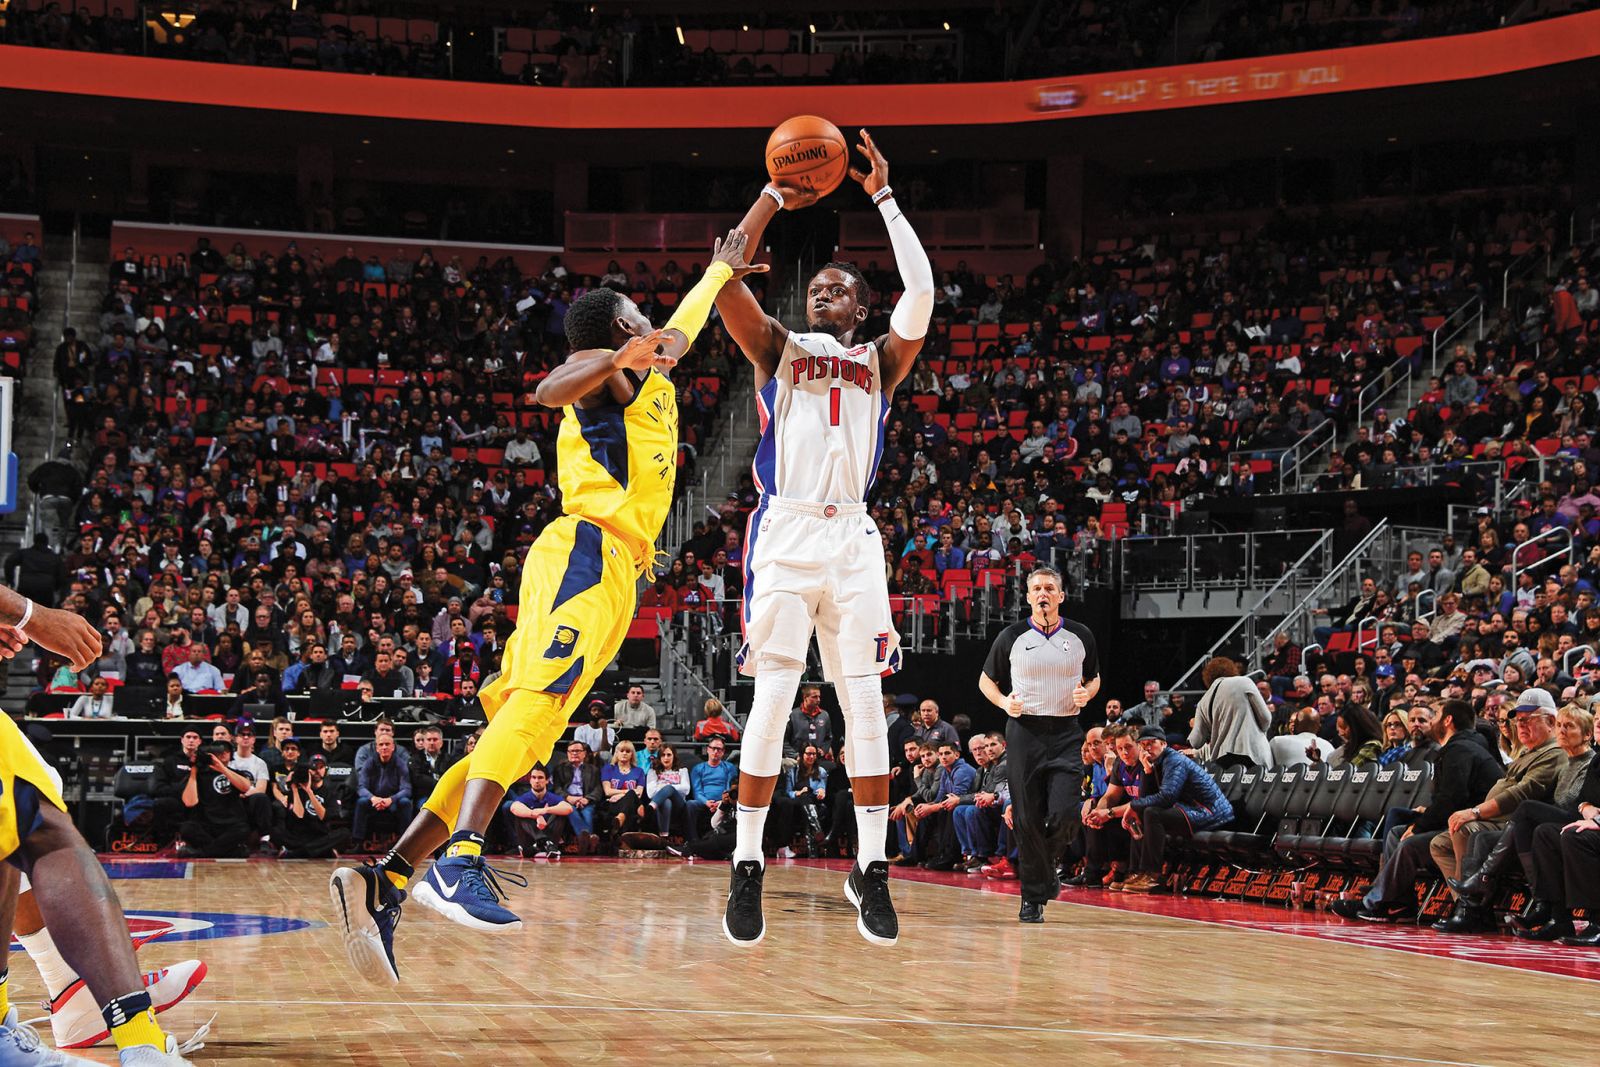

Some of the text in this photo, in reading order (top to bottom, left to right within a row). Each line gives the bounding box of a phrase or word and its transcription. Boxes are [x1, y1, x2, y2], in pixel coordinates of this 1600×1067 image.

[773, 144, 828, 171] SPALDING
[791, 355, 874, 395] PISTONS
[830, 387, 841, 426] 1
